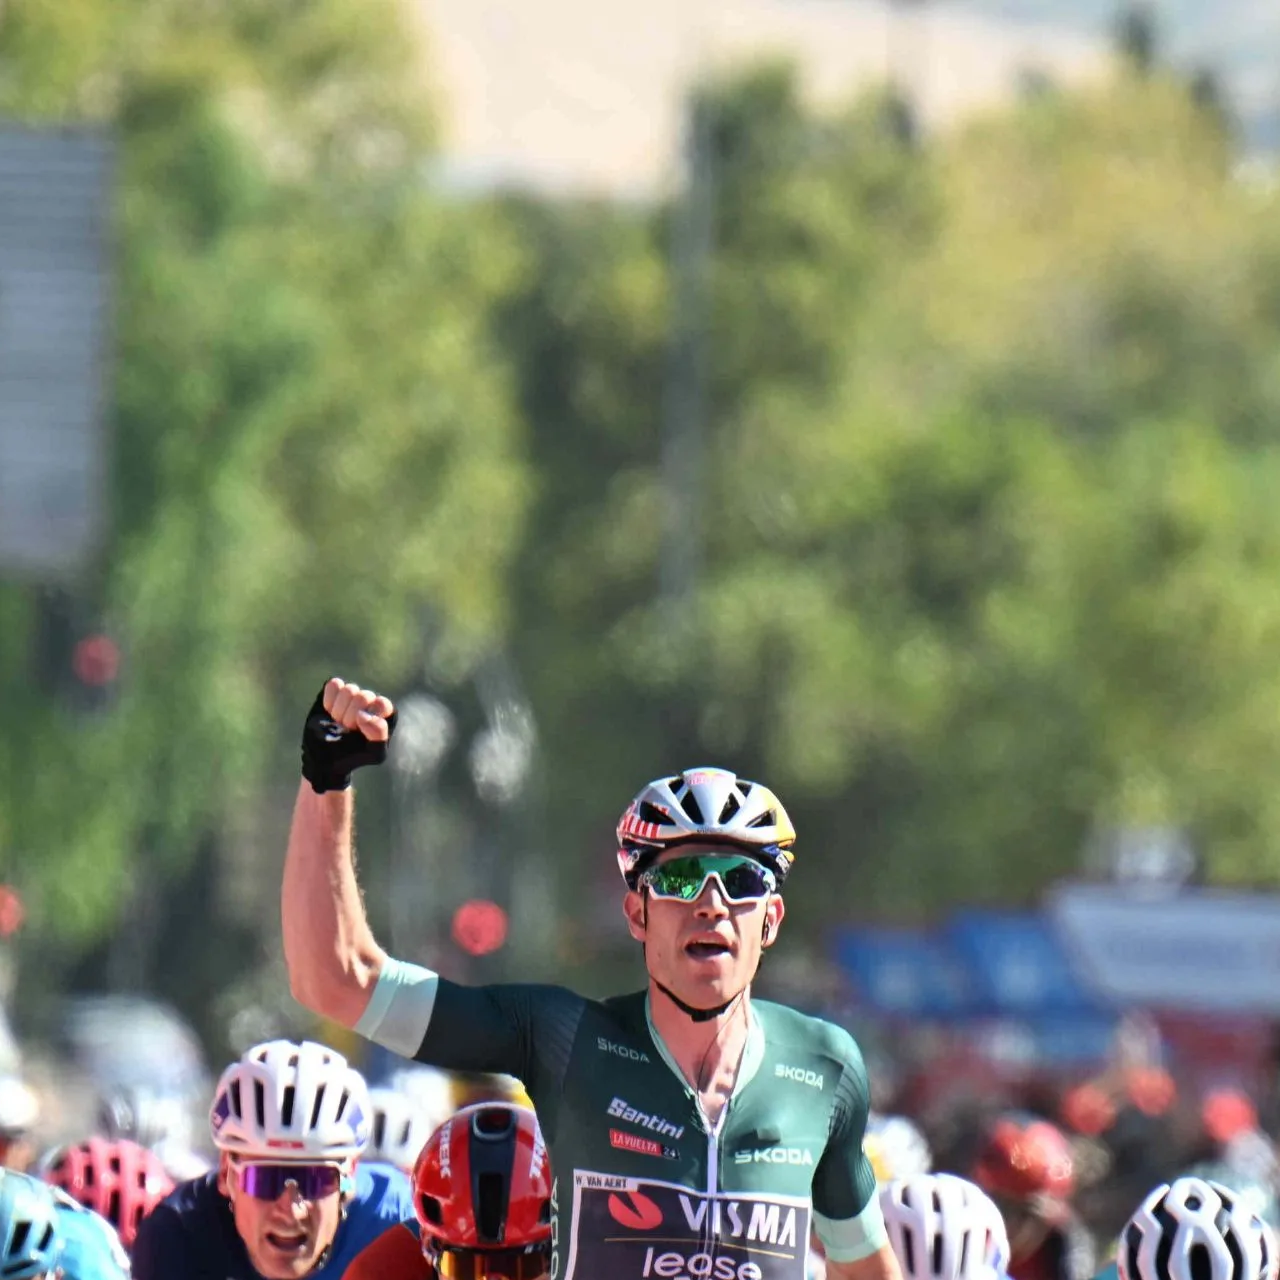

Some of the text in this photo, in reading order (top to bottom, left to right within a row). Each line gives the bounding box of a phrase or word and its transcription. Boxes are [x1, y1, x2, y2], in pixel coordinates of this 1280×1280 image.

[775, 1064, 824, 1090] SKODA
[606, 1097, 685, 1140] Santini
[735, 1147, 813, 1166] SKODA
[587, 1175, 602, 1187] VAN
[678, 1194, 796, 1247] VISMA
